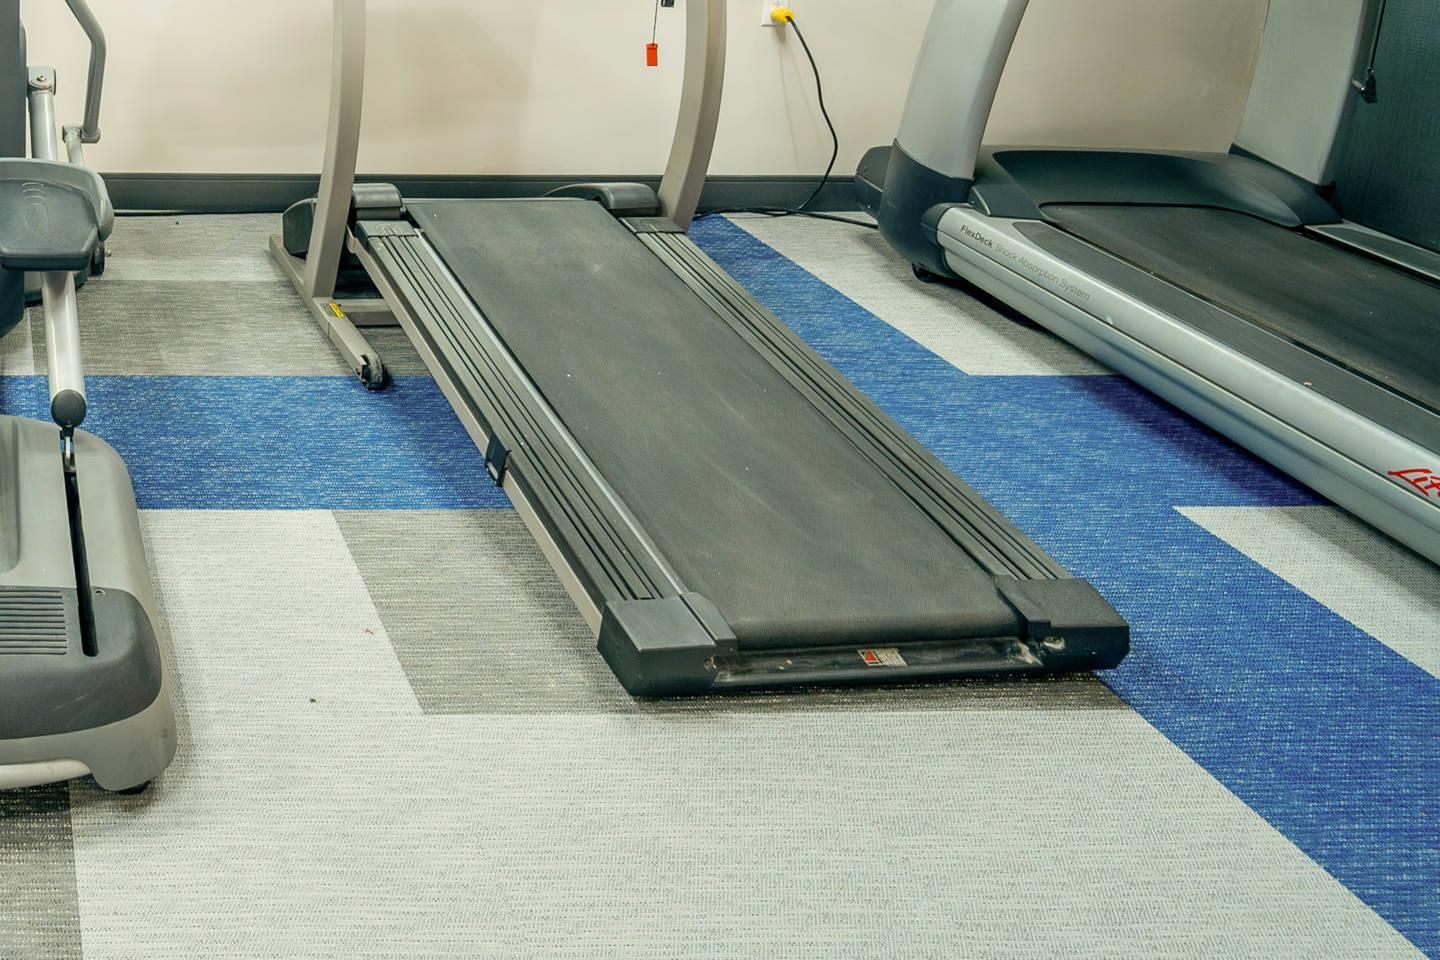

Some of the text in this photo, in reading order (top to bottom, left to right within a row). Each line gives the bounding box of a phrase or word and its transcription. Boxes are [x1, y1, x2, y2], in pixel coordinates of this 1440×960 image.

[960, 224, 1090, 301] FlexDeck Shock Absorption System
